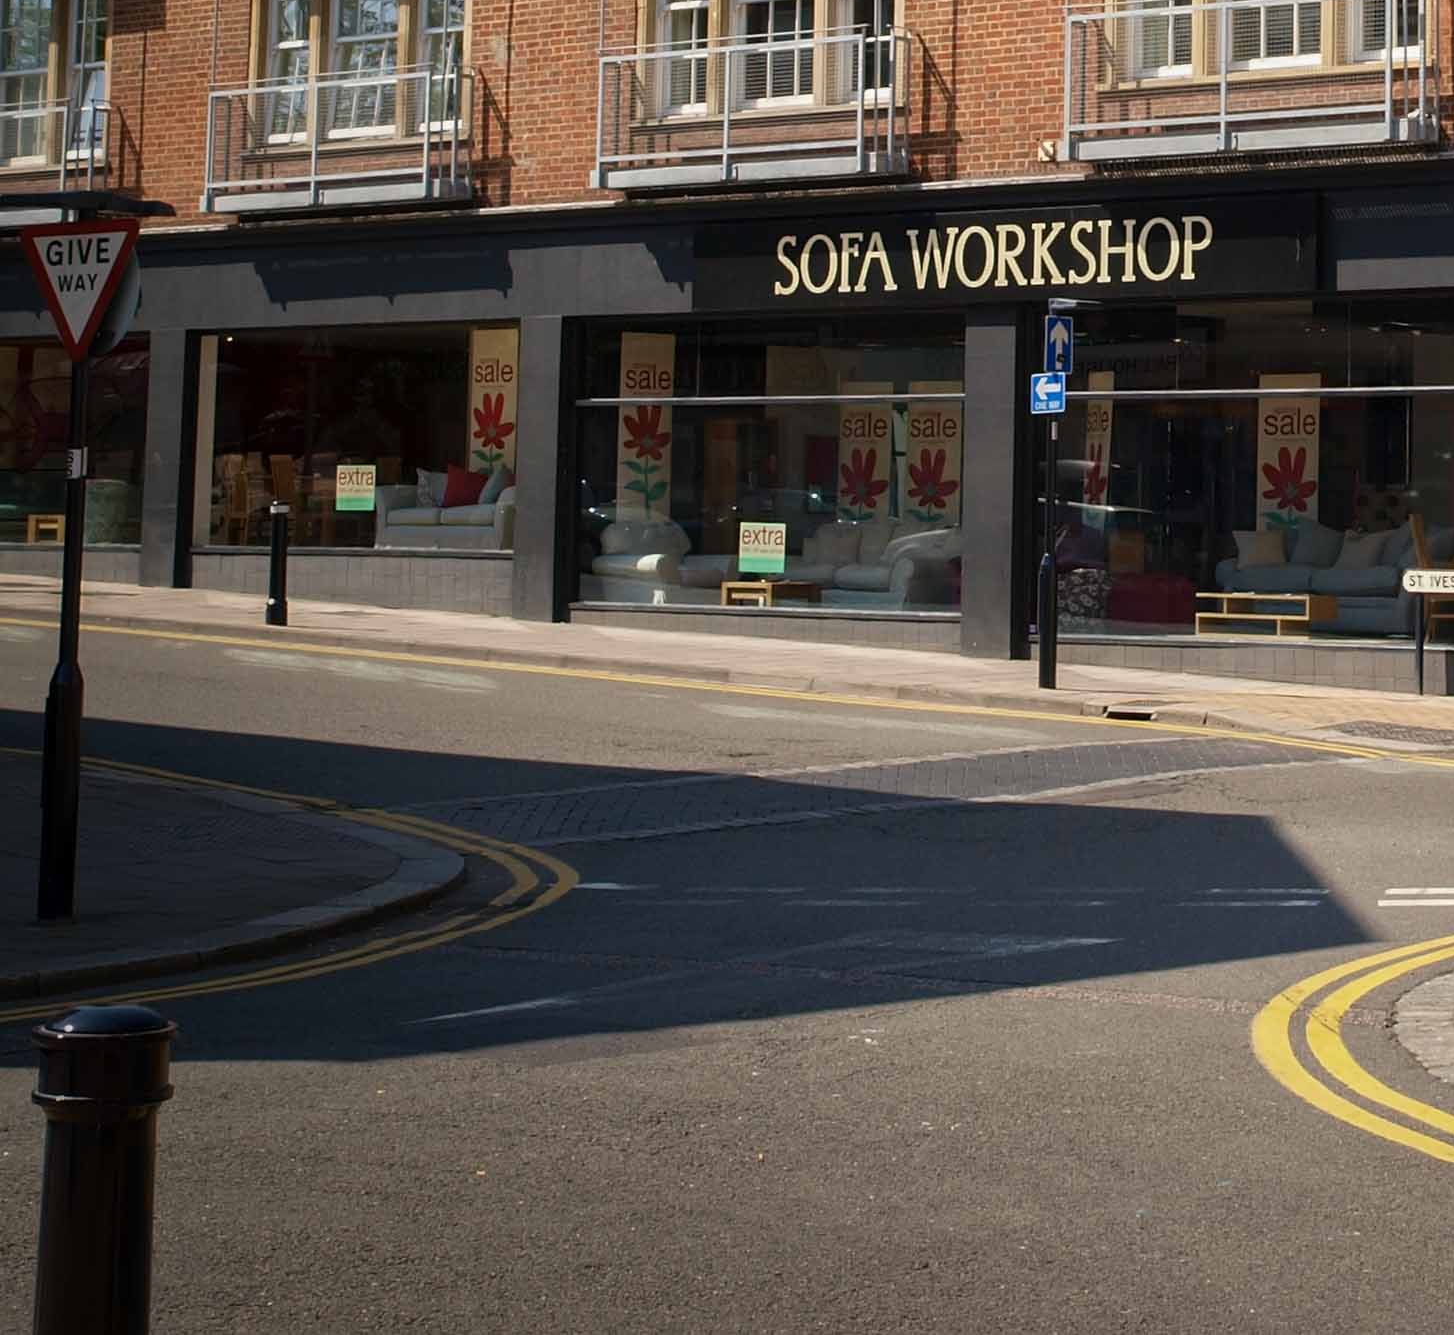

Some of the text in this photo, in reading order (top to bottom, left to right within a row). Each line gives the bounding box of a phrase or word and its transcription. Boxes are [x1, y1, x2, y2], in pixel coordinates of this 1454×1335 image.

[46, 237, 110, 266] GIVE
[774, 216, 1213, 295] SOFA WORKSHOP
[58, 273, 98, 292] WAY
[475, 358, 513, 383] sale
[625, 364, 671, 390] sale
[841, 412, 888, 438] sale
[911, 412, 957, 438] sale
[1264, 407, 1316, 435] sale
[339, 468, 374, 486] extra
[742, 526, 784, 546] extra
[1408, 575, 1424, 587] ST
